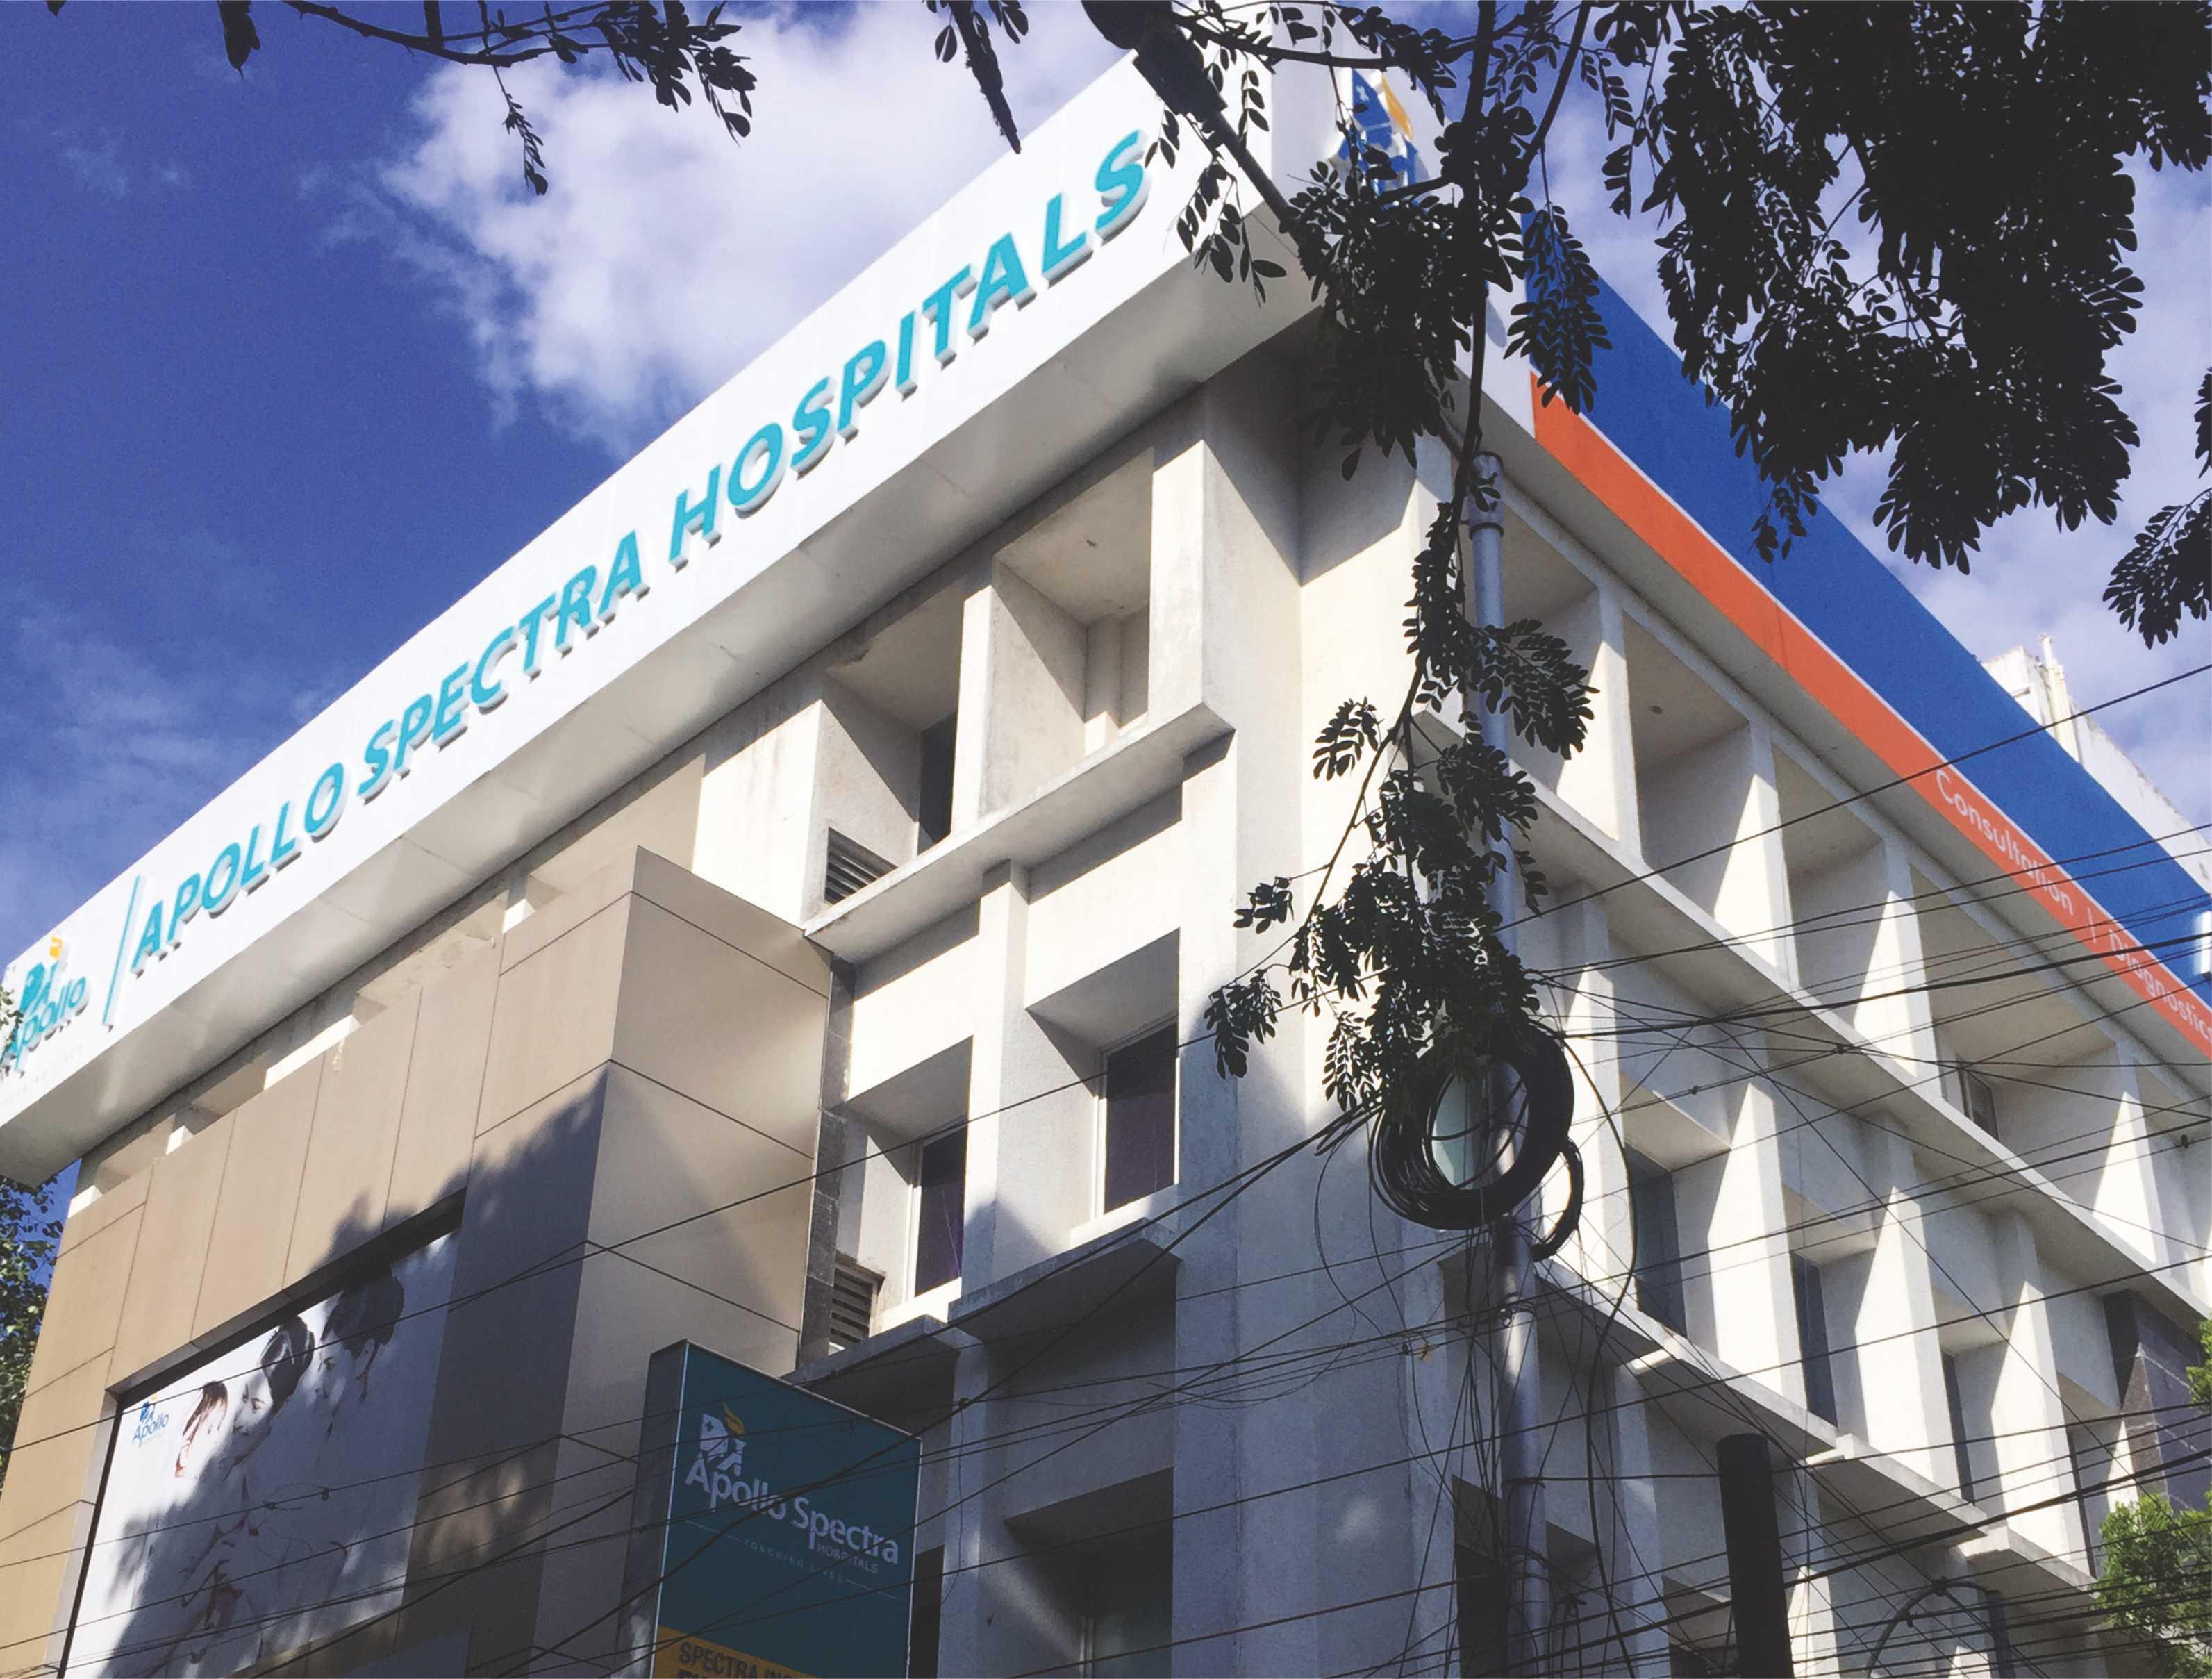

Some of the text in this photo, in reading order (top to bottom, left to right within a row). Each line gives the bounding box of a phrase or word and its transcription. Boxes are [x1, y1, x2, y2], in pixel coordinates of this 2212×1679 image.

[130, 129, 1147, 974] APOLLO SPECTRA HOSPITALS
[1936, 768, 2074, 916] Consultation
[133, 1412, 169, 1447] Apollo
[685, 1455, 899, 1564] Apollo Spectra
[815, 1542, 879, 1574] HOSPITALS
[679, 1641, 758, 1678] SPECTRA
